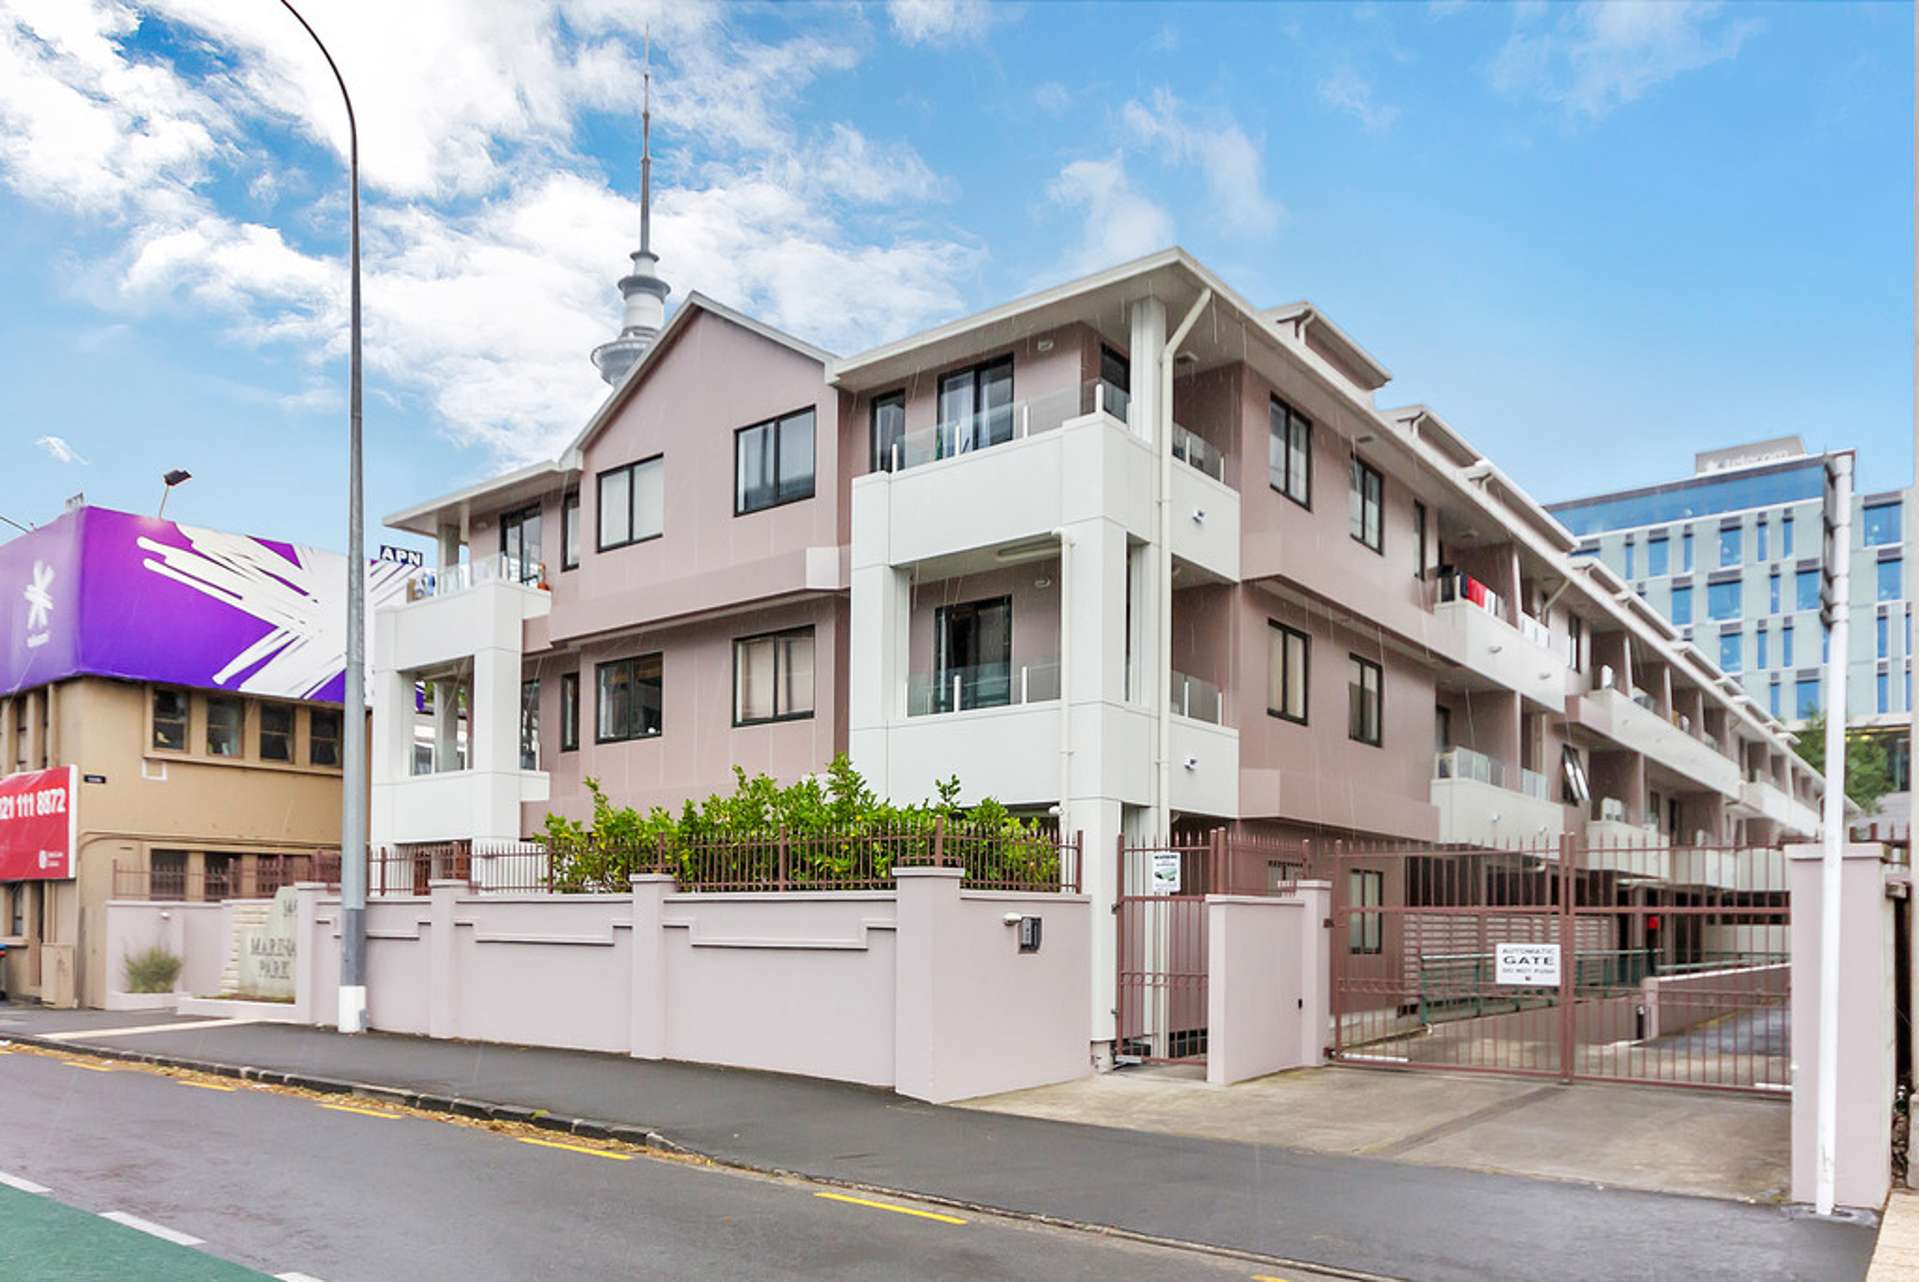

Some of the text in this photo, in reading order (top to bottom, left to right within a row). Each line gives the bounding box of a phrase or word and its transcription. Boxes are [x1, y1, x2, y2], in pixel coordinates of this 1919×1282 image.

[381, 547, 421, 566] APN
[0, 787, 66, 820] 21 111 8872
[1503, 955, 1555, 965] GATE
